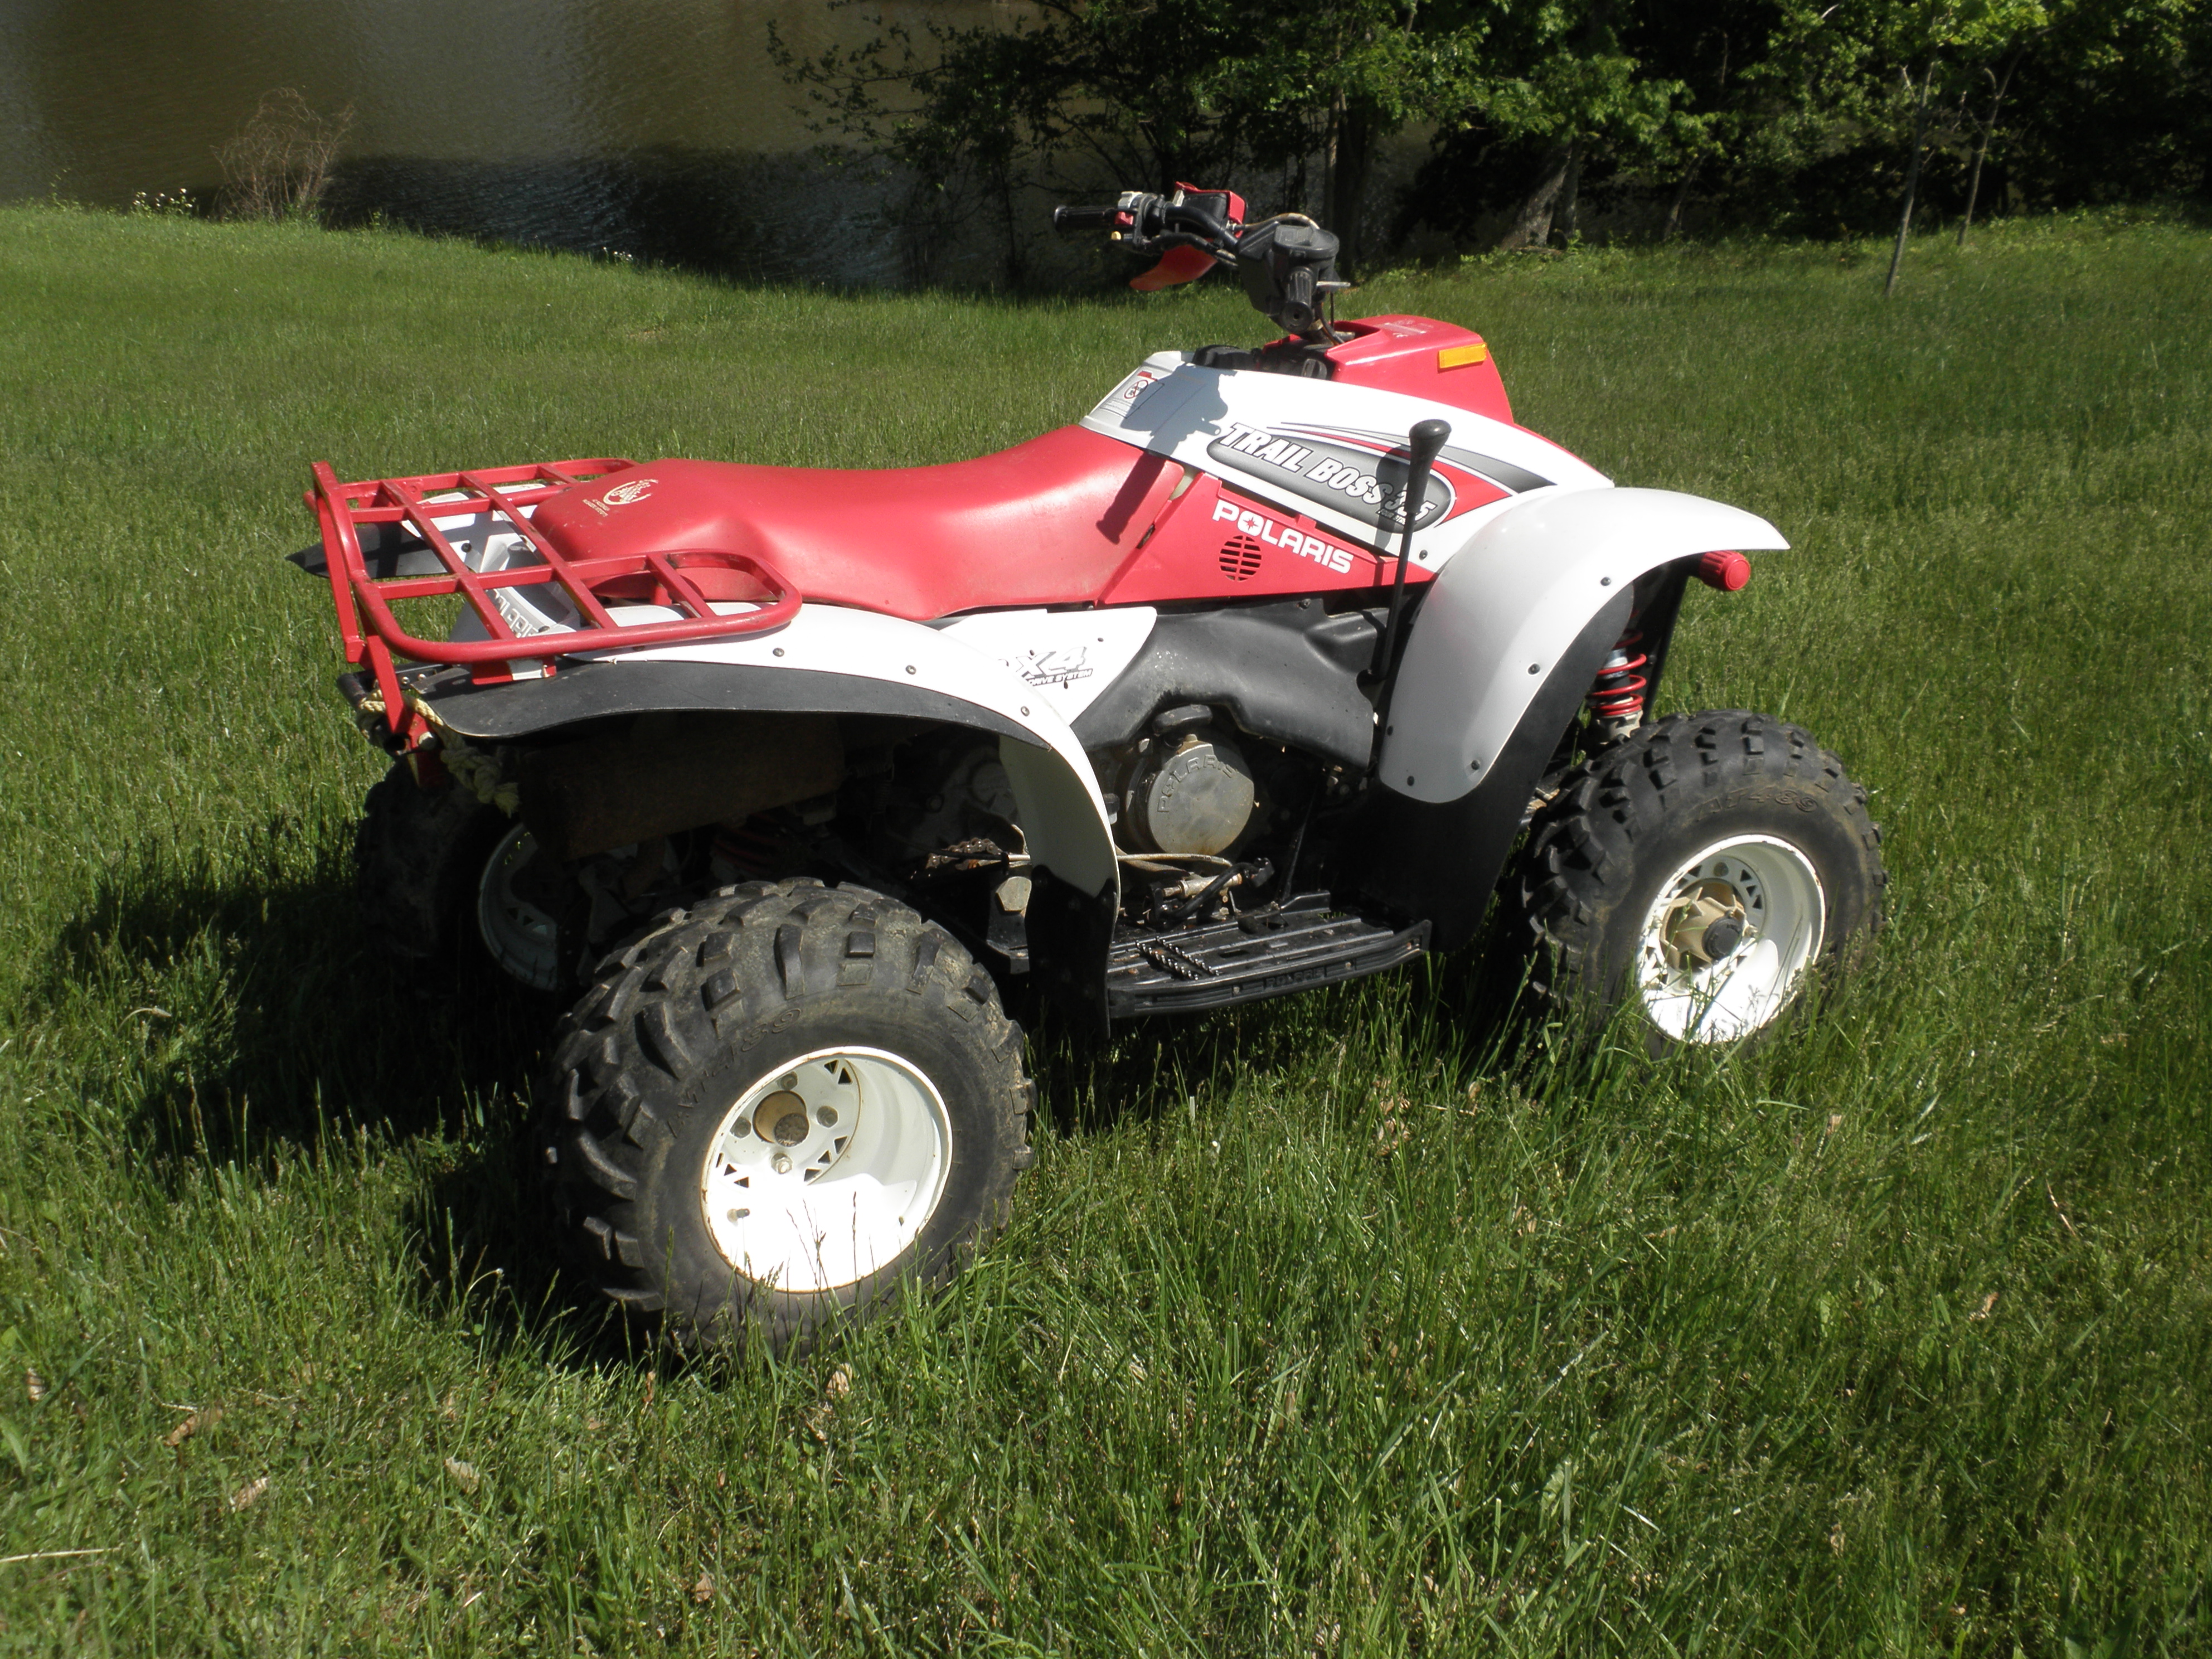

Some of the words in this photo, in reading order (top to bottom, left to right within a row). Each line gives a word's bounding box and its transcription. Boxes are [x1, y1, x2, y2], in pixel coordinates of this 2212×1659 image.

[1218, 422, 1314, 473] TRAIL
[1303, 457, 1394, 505] BOSS
[1384, 489, 1438, 522] 35
[1212, 499, 1354, 574] POLARIS
[1055, 669, 1093, 682] SYSTEM
[1157, 754, 1238, 812] POLARIS
